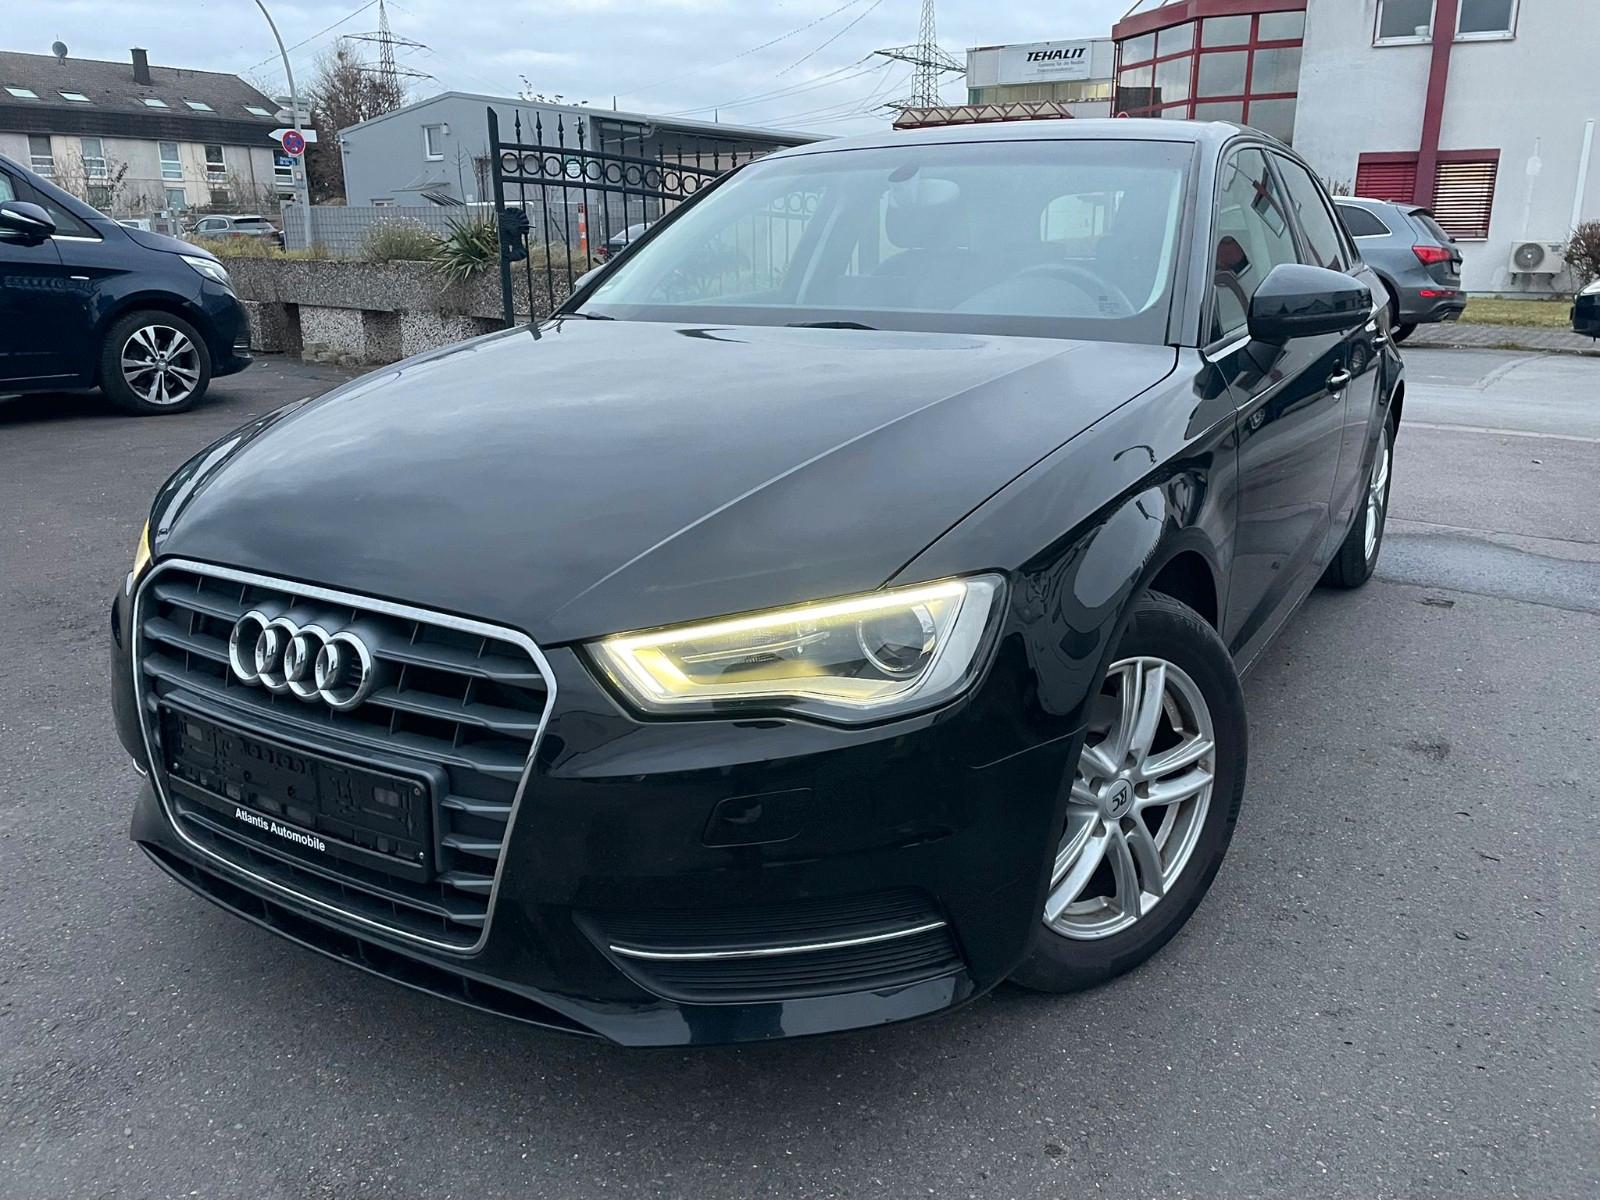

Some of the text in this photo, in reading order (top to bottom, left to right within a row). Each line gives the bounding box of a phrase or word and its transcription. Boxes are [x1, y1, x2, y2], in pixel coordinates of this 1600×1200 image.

[1027, 48, 1086, 62] TEHALIT
[235, 807, 326, 851] Atlantis Automobile
